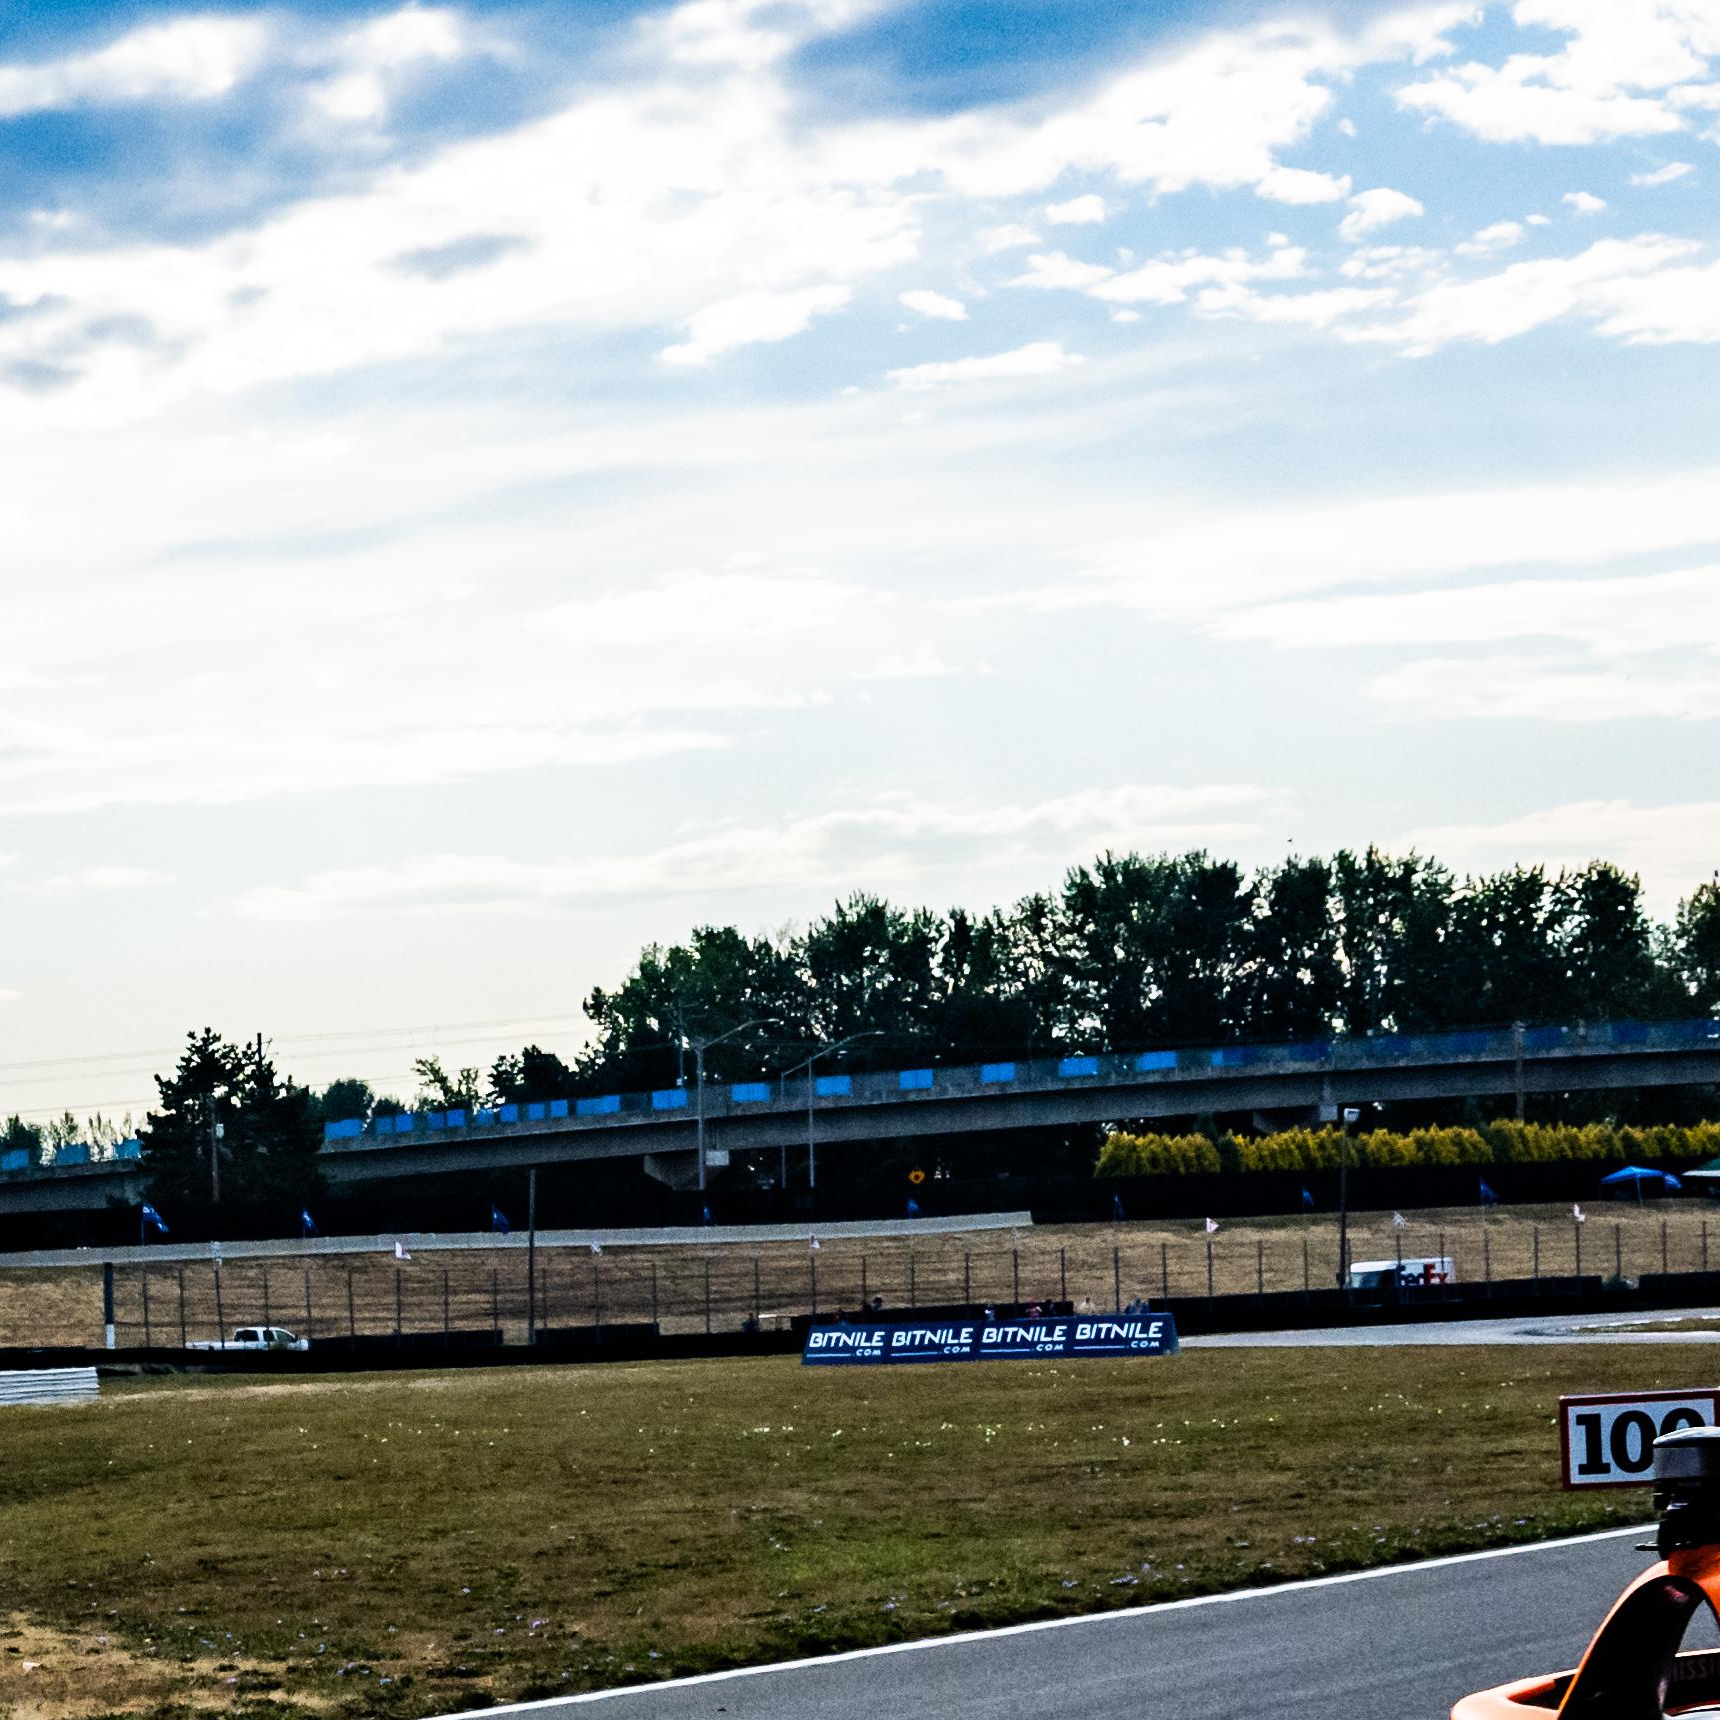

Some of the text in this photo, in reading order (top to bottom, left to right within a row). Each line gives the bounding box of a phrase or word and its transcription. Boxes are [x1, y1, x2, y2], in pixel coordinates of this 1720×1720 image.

[808, 1331, 886, 1348] BITNILE
[891, 1327, 974, 1346] BITNILE
[982, 1325, 1067, 1343] BITNILE
[1075, 1321, 1163, 1340] BITNILE
